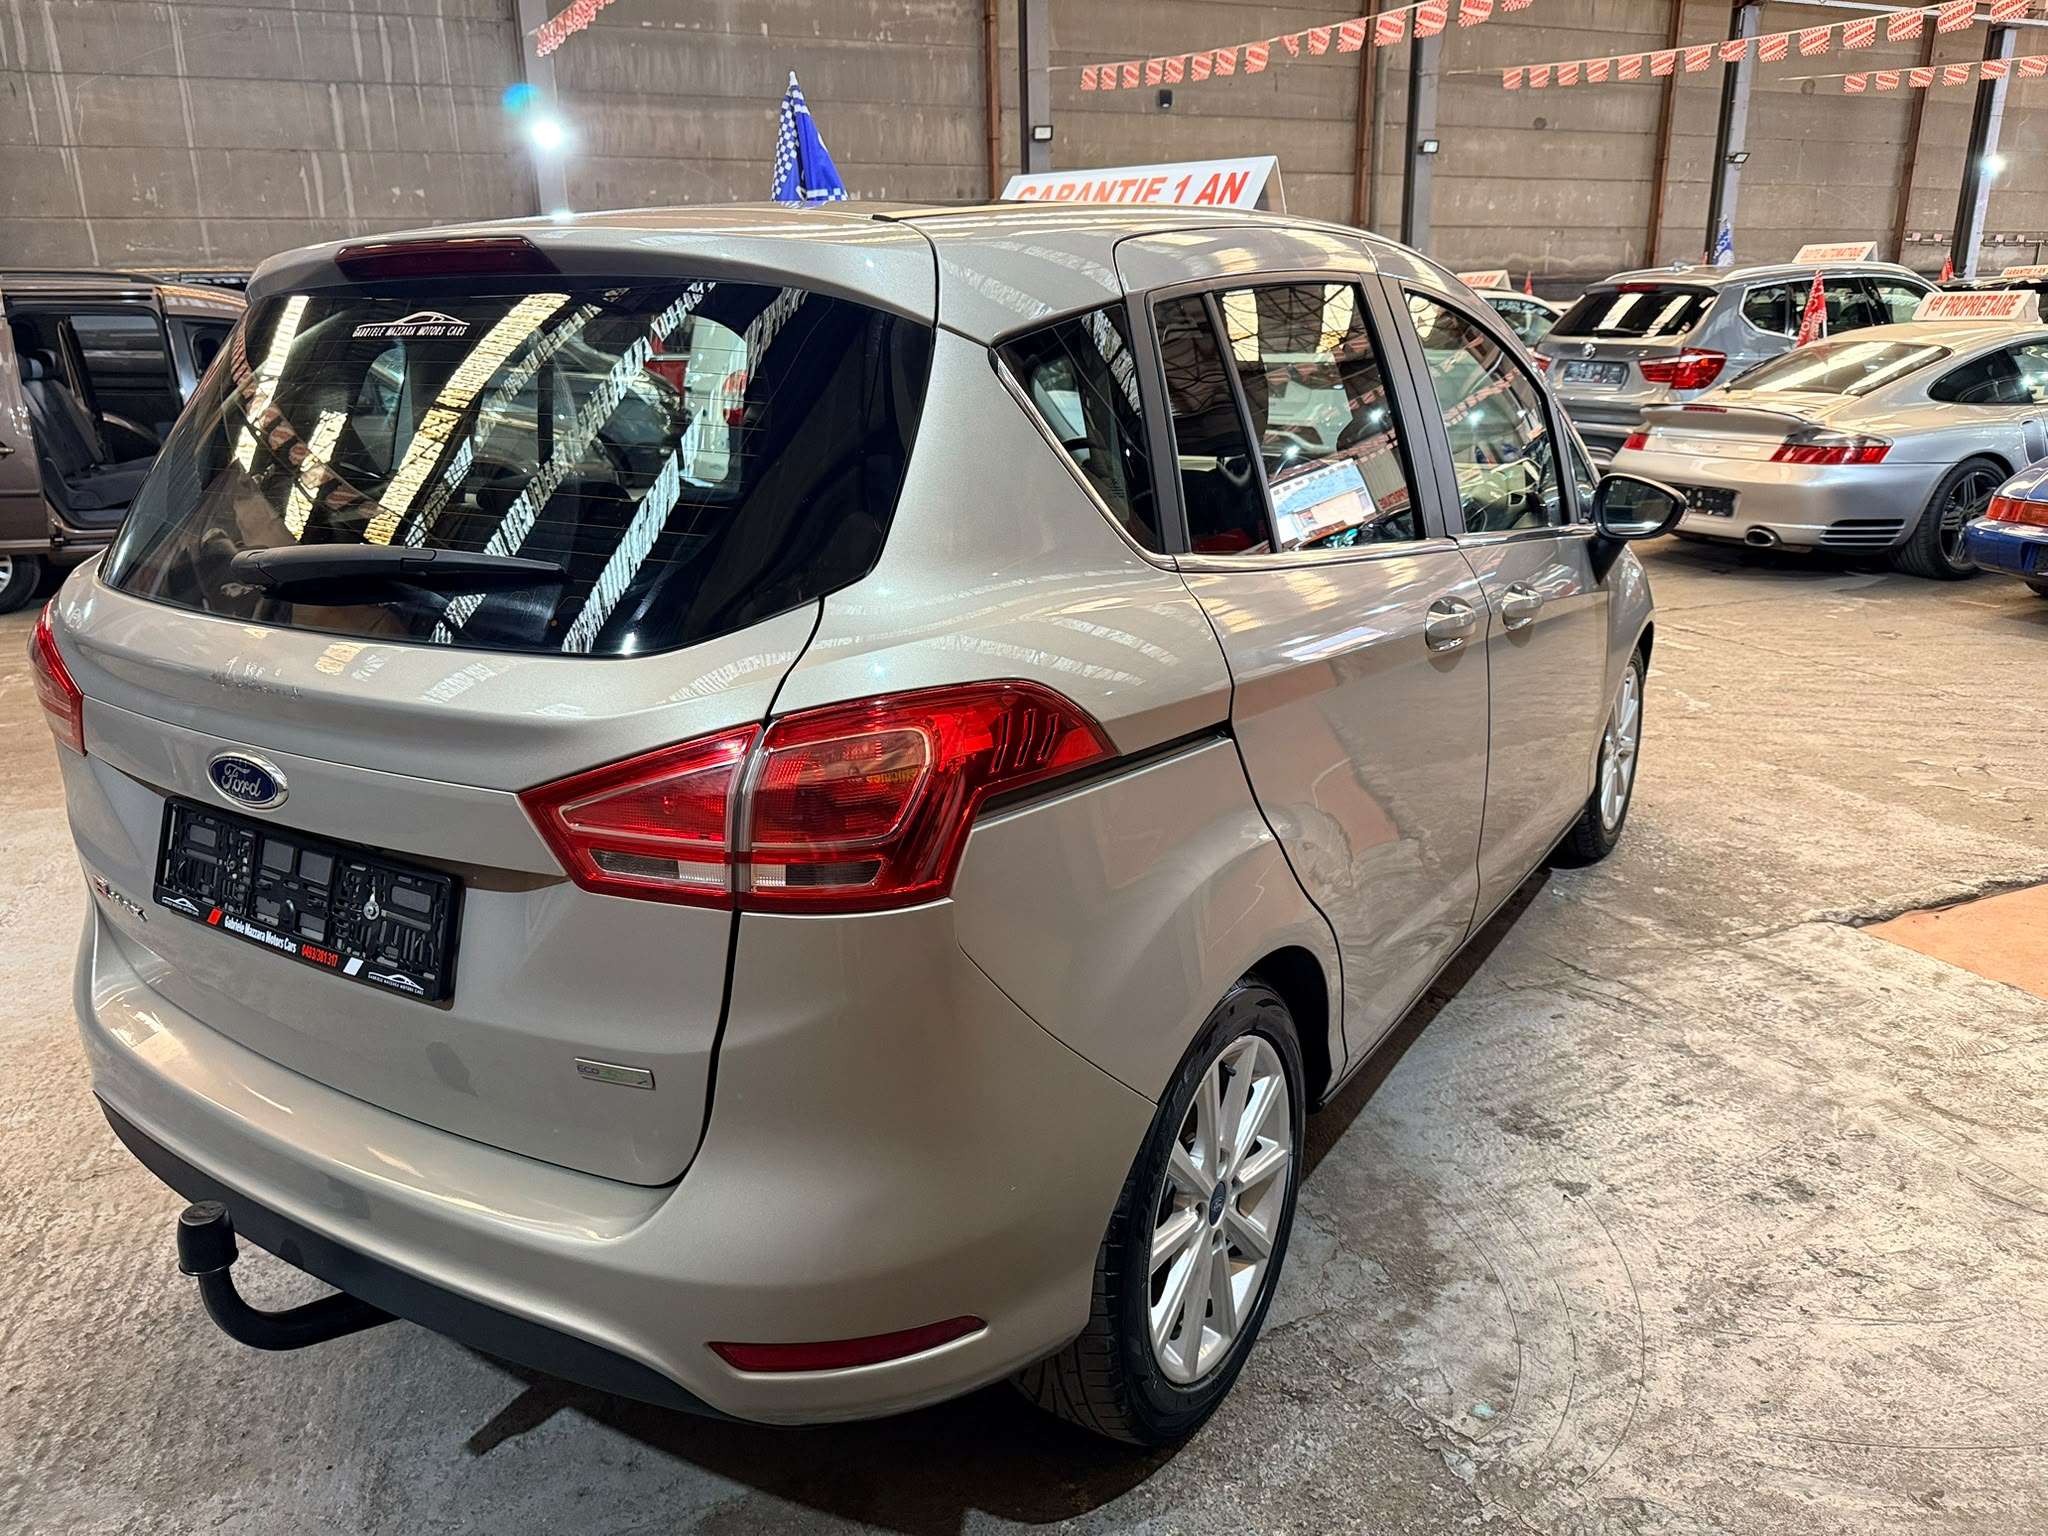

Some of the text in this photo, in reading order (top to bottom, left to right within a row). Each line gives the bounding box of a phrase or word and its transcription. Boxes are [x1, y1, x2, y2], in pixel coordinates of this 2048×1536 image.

[1889, 14, 1922, 36] OCCASION
[1938, 3, 1975, 27] OCCASION
[1844, 24, 1875, 43] OCCASION
[1174, 174, 1193, 204] 1
[1194, 171, 1250, 205] AN
[1940, 294, 2022, 317] PROPRIETAIRE
[385, 326, 416, 337] MAZZARA
[416, 325, 446, 336] MOTORS
[446, 325, 468, 337] CARS
[220, 762, 262, 798] Ford
[224, 915, 297, 954] Gabriele Mazzara Motors Cars
